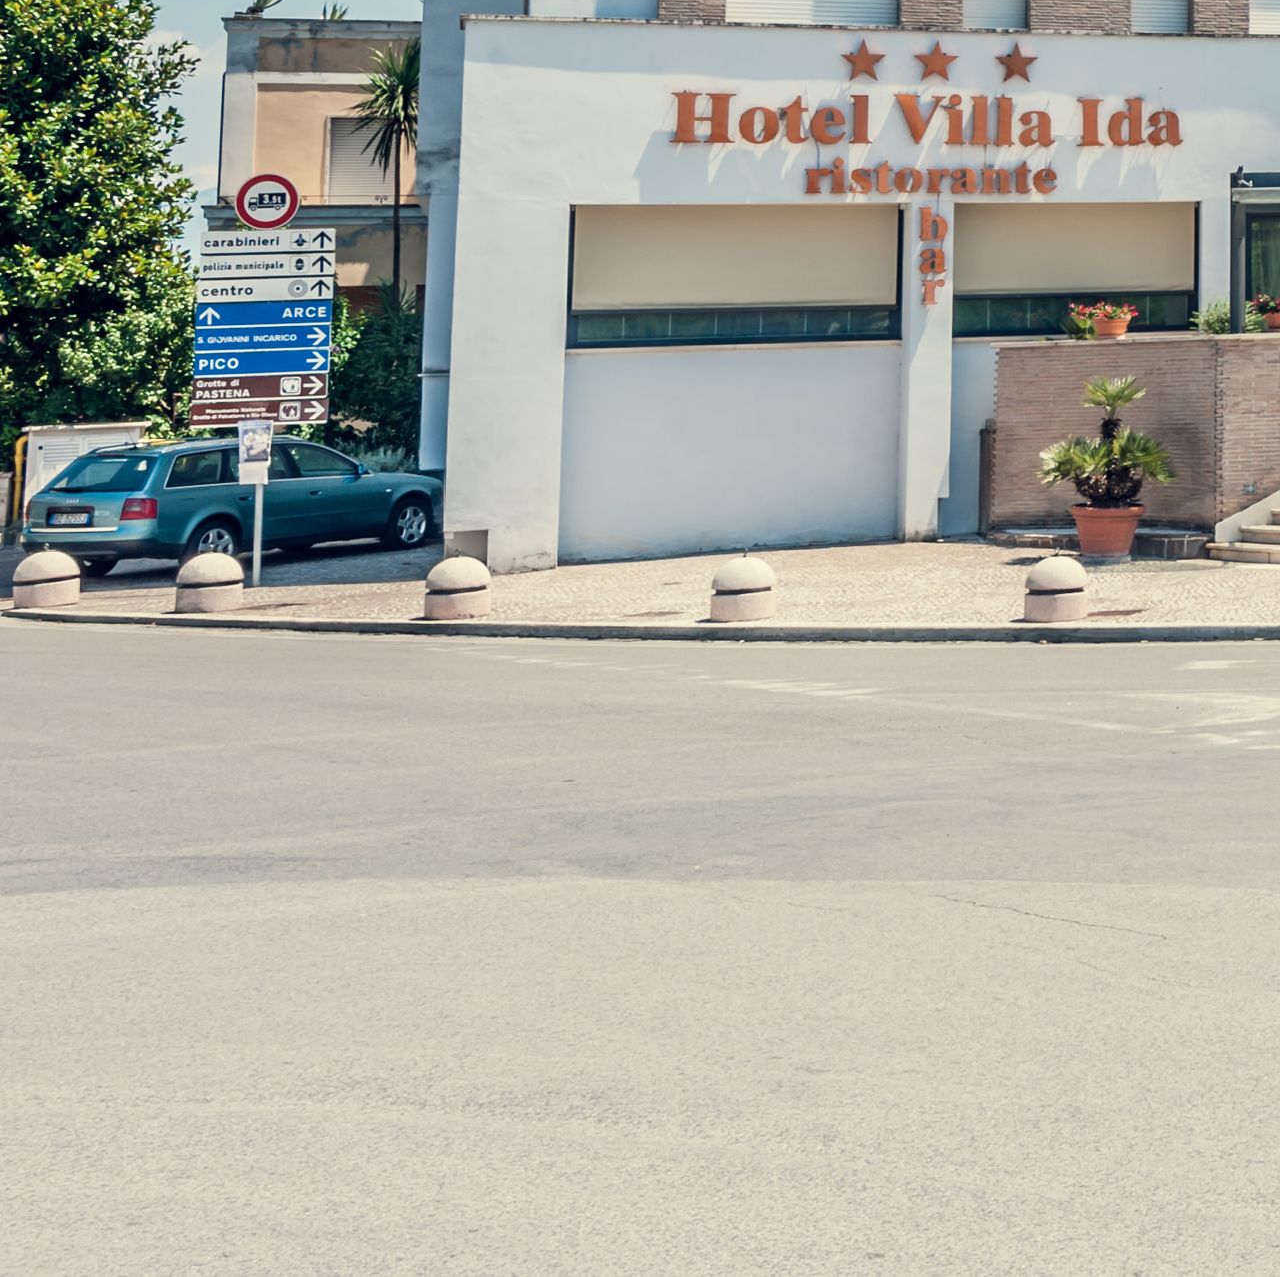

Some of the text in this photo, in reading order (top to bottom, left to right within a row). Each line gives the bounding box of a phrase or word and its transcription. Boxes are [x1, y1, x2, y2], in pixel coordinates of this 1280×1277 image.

[669, 92, 1184, 147] Hotel Villa Ida
[804, 156, 1058, 195] ristorante
[203, 236, 280, 248] carabinieri
[918, 206, 948, 306] bar
[202, 261, 284, 272] polizia municipale
[201, 285, 254, 297] centro
[282, 306, 327, 319] ARCE
[207, 335, 250, 344] GIOVANNI
[253, 333, 298, 342] INCARICO
[198, 357, 239, 371] PICO
[196, 379, 240, 388] Grotte di
[195, 388, 250, 399] PASTENA
